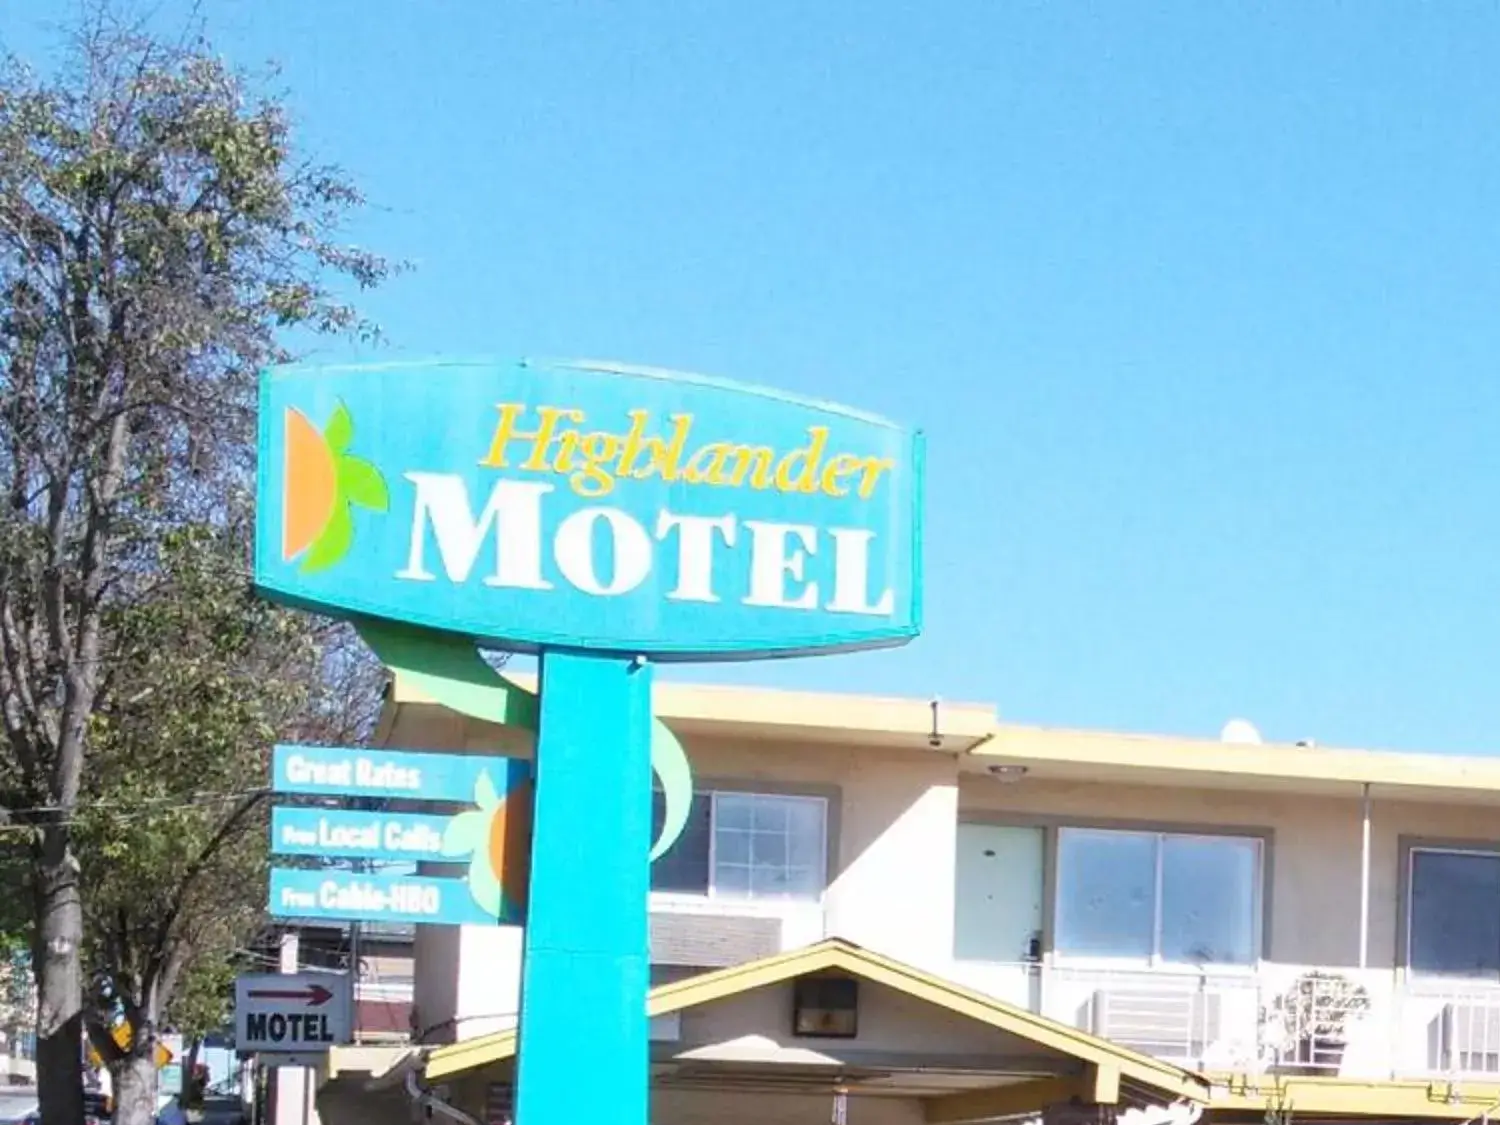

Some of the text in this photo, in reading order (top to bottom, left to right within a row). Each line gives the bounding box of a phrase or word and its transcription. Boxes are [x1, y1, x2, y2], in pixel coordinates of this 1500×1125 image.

[477, 402, 897, 499] Highlander
[394, 472, 896, 616] MOTEL
[285, 755, 422, 789] Great Rates
[246, 1013, 334, 1042] MOTEL
